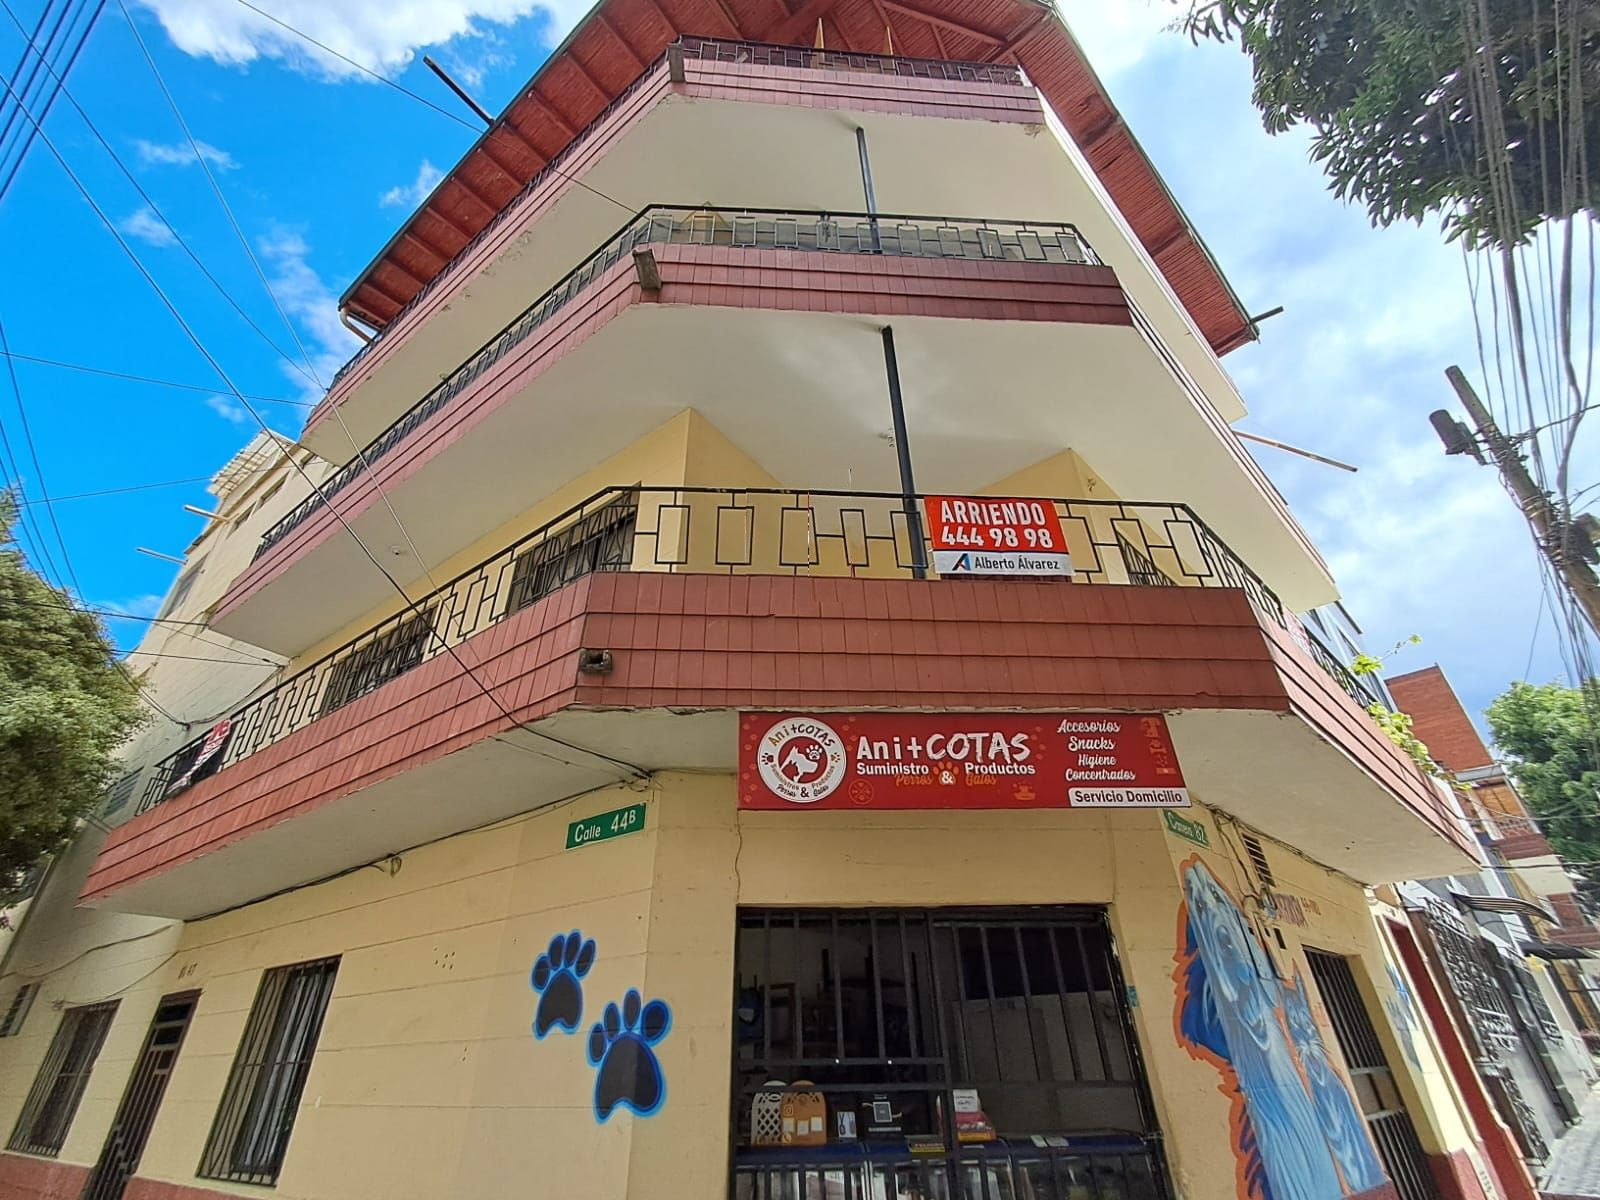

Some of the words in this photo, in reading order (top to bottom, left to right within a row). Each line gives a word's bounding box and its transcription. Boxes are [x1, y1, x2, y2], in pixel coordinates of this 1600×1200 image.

[941, 501, 1046, 526] ARRIENDO
[941, 526, 984, 546] 444
[989, 527, 1019, 548] 98
[1023, 528, 1054, 549] 98
[974, 556, 1015, 570] Alberto
[1018, 555, 1060, 570] Álvarez
[1056, 719, 1121, 733] Accesorios
[1068, 736, 1116, 752] Snacks
[856, 762, 930, 775] Suministro
[964, 762, 1036, 775] Productos
[1078, 754, 1117, 769] Higiene
[895, 772, 934, 787] Perros
[941, 771, 954, 785] &
[1065, 768, 1136, 782] Concentrados
[800, 786, 810, 798] &
[1075, 790, 1123, 803] Servicio
[1125, 790, 1182, 803] Domicilio
[574, 823, 601, 843] Calle
[610, 809, 637, 833] 44B
